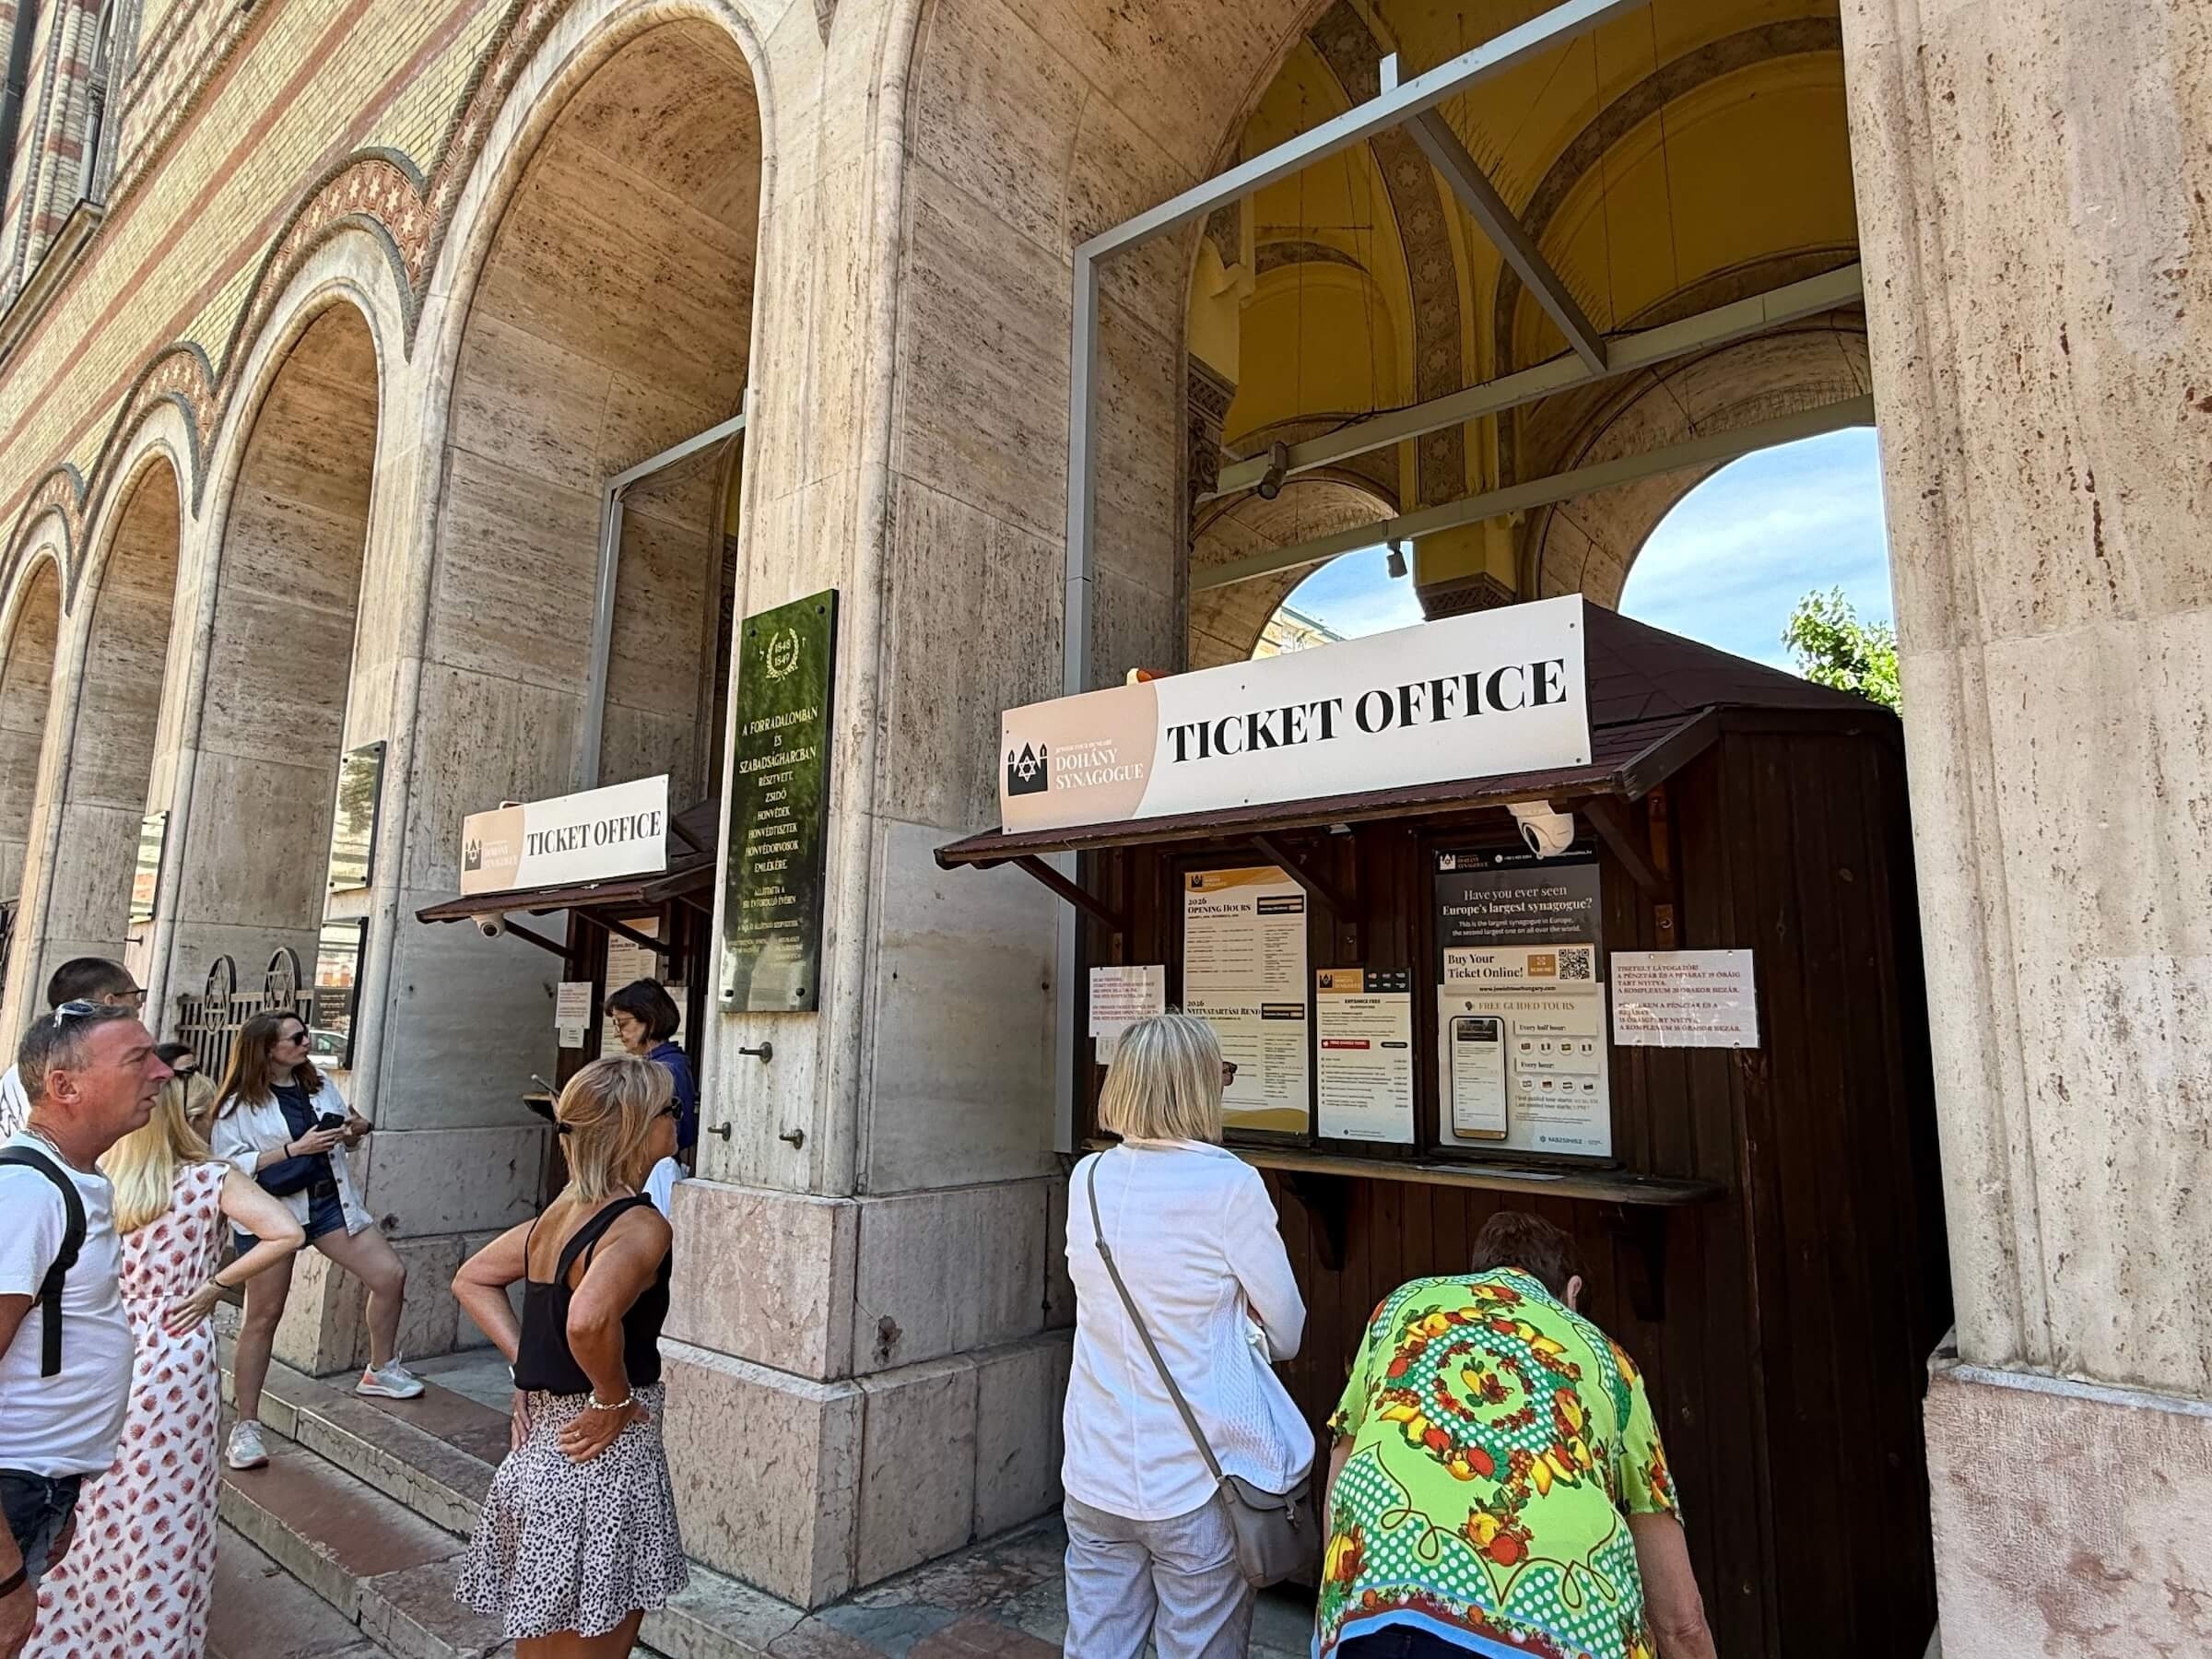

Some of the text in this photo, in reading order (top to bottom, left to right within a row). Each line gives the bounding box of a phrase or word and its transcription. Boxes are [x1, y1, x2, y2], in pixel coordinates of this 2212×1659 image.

[774, 639, 791, 653] 1848
[774, 653, 790, 666] 1849
[1166, 658, 1569, 764] TICKET OFFICE
[742, 706, 818, 736] A FORRADALOMBAN
[774, 734, 782, 747] ÉS
[739, 747, 817, 774] SZABADSÁGHARCBAN
[1055, 747, 1118, 771] DOHÁNY
[1056, 763, 1144, 790] SYNAGOGUE
[765, 788, 787, 803] ZSIDÓ
[758, 806, 790, 821] HONVÉDEK
[527, 824, 591, 856] TICKET
[594, 810, 662, 846] OFFICE
[748, 822, 798, 840] HONVÉDTISZTEK
[745, 840, 799, 856] HONVÉDORVOSOK
[754, 858, 788, 873] EMLÉKÉRE
[1464, 886, 1567, 903] Have you ever seen
[1187, 905, 1221, 914] OPENING
[1223, 904, 1252, 912] HOURS
[1442, 898, 1593, 917] Europe's largest synagogue?
[1448, 953, 1494, 965] Buy Your
[1448, 967, 1480, 979] Ticket
[1483, 966, 1524, 978] Online!
[1478, 1001, 1575, 1010] FREE GUIDED TOURS
